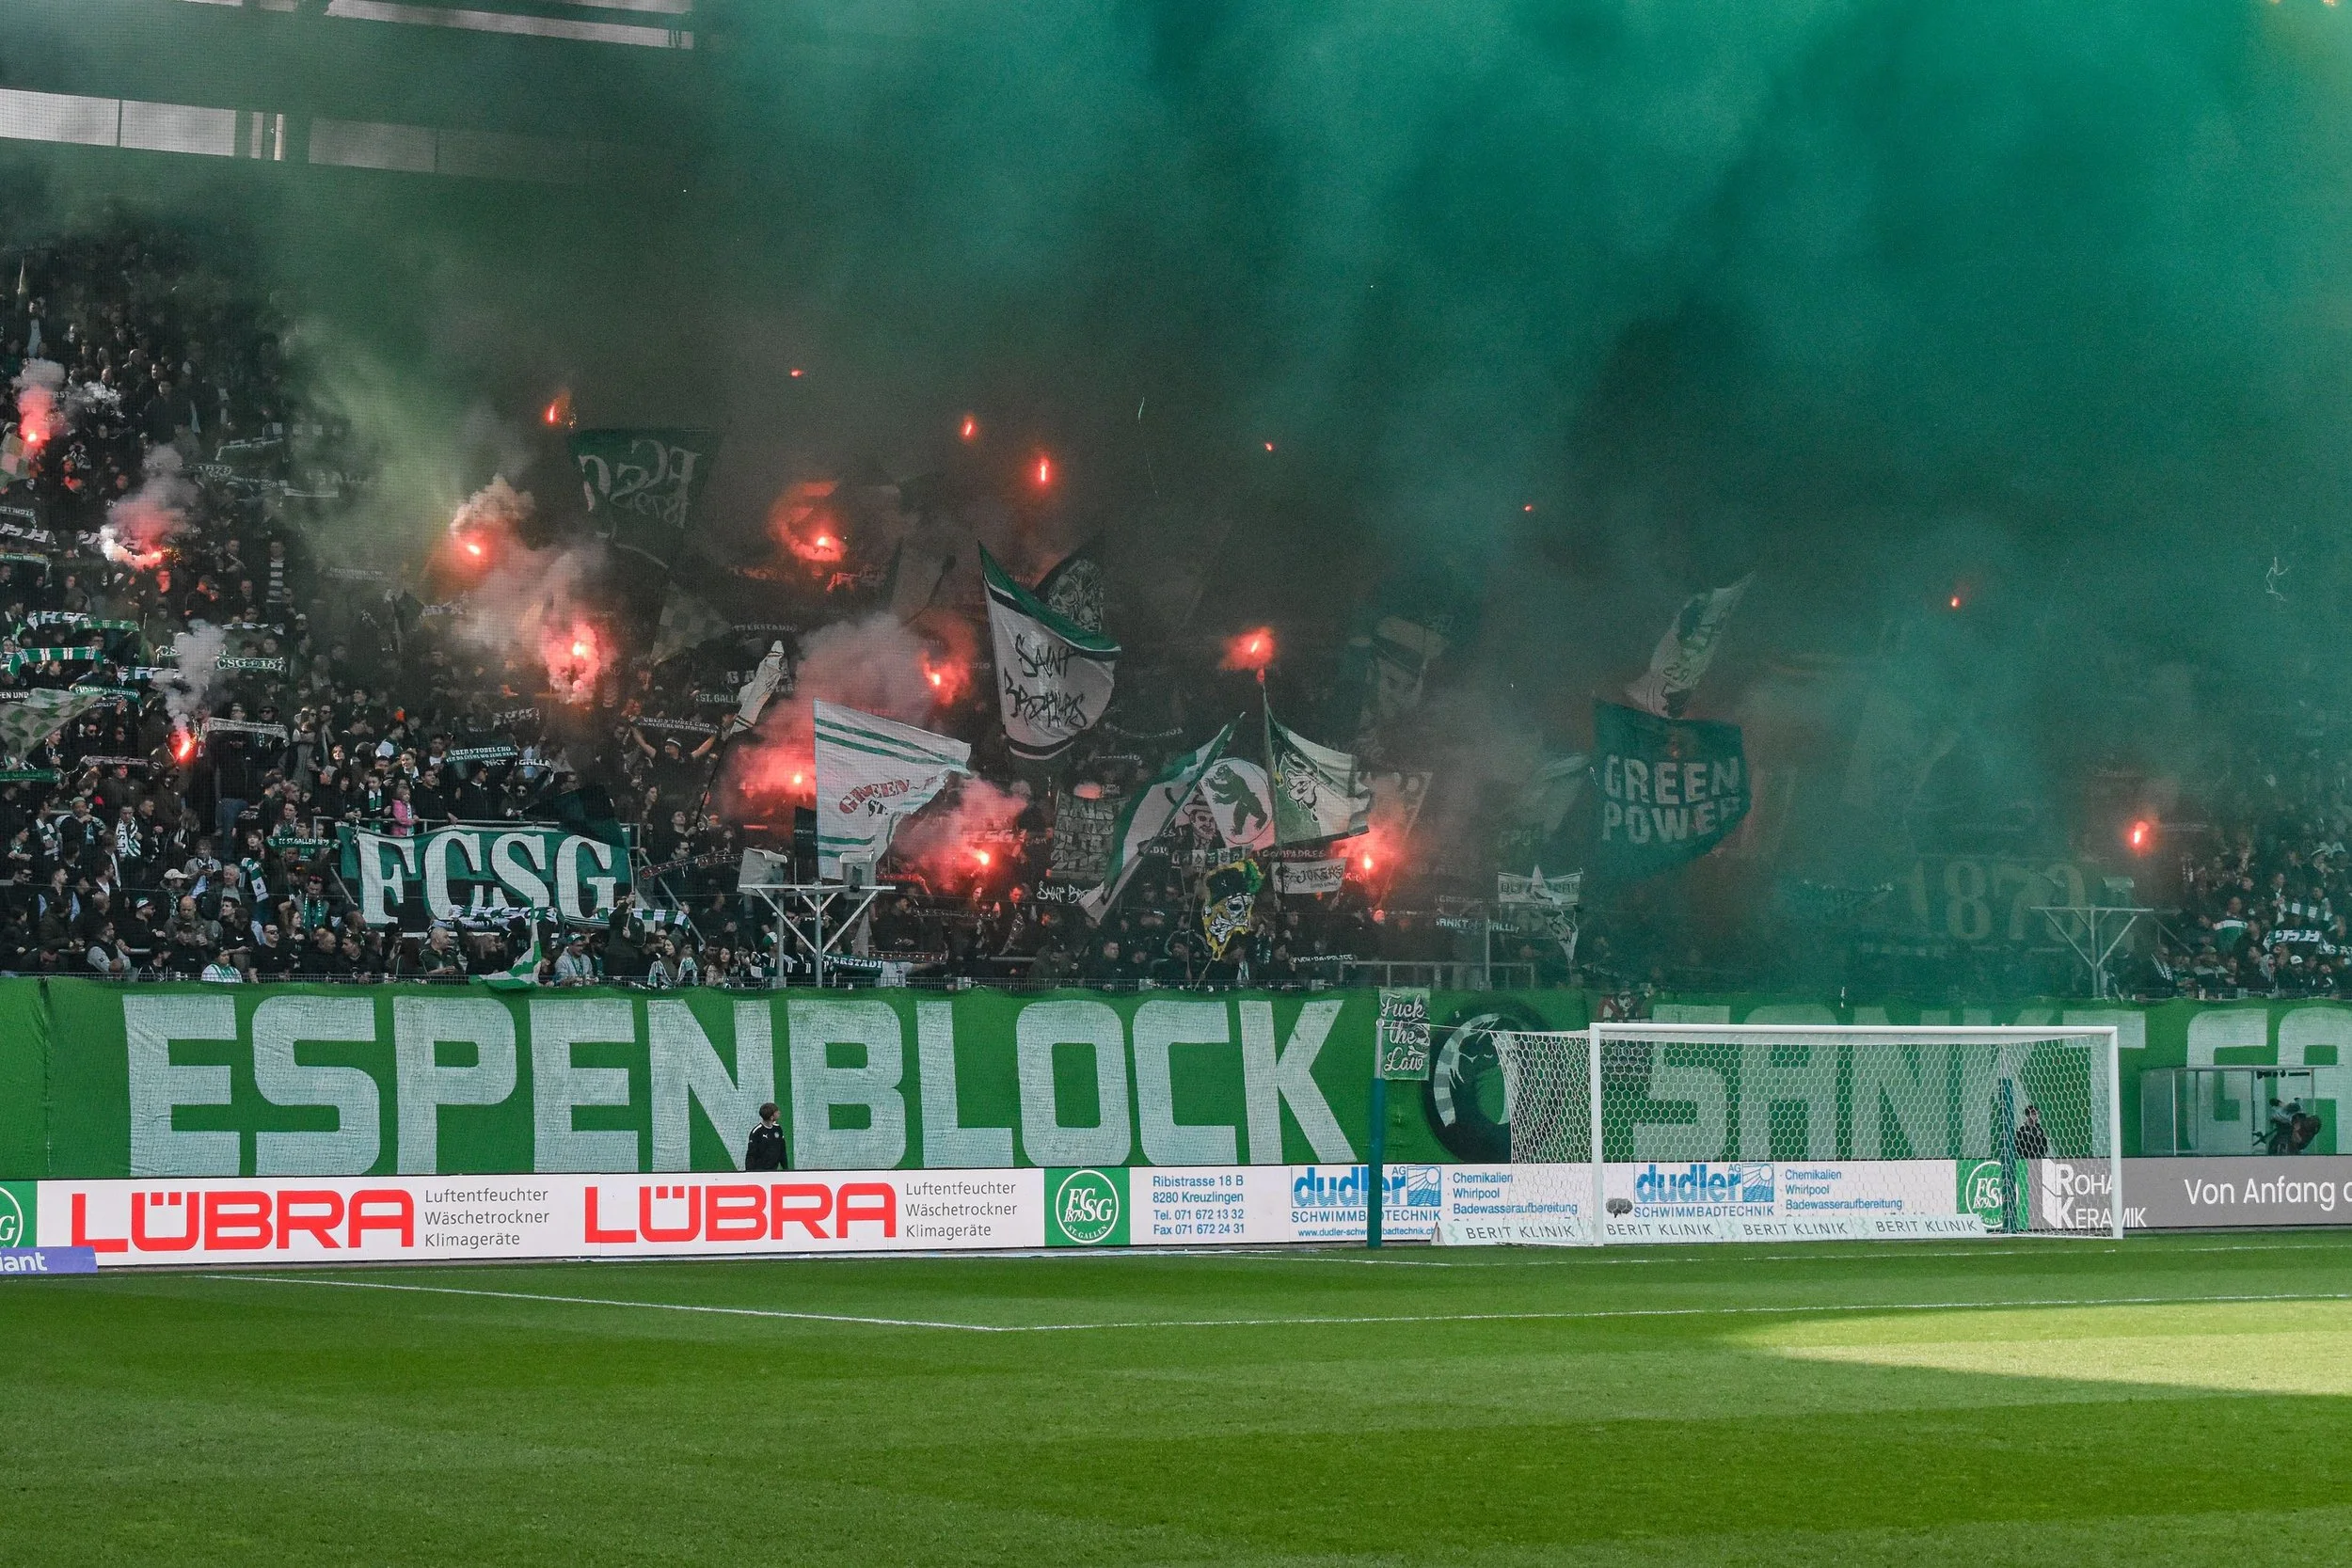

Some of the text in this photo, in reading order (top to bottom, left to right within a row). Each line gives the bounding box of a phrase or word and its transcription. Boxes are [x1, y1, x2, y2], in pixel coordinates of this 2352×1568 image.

[1605, 753, 1739, 806] GREEN
[358, 831, 619, 924] FCSG
[1380, 992, 1425, 1019] Fuck
[1389, 1022, 1418, 1045] the
[1384, 1046, 1424, 1071] Law
[123, 995, 1353, 1178] ESPENBLOCK
[1632, 1003, 2146, 1160] SANKT
[1391, 1166, 1406, 1176] AG
[1728, 1164, 1740, 1173] AG
[1785, 1169, 1841, 1180] Chemikalien
[1152, 1175, 1244, 1187] Ribistrasse 18 B
[1453, 1172, 1513, 1183] Chemikalien
[1636, 1164, 1740, 1203] dudler
[425, 1188, 548, 1203] Luftentfeuchter
[906, 1181, 1016, 1196] Luftentfeuchter
[1453, 1188, 1500, 1200] Whirlpool
[1785, 1184, 1830, 1196] Whirlpool
[2185, 1179, 2233, 1205] Von
[2243, 1175, 2335, 1212] Anfang
[1152, 1191, 1244, 1205] 8280 Kreuzlingen
[1786, 1198, 1902, 1211] Badewasseraufbereitung
[585, 1182, 896, 1243] LÜBRA
[906, 1202, 1018, 1217] Wäschetrockner
[1153, 1209, 1244, 1220] Tel. 071 672 13 32
[1453, 1203, 1578, 1215] Badewasseraufbereitung
[1634, 1205, 1774, 1218] SCHWIMMBADTECHNIK
[72, 1189, 414, 1253] LÜBRA
[425, 1210, 549, 1225] Wäschetrockner
[1292, 1210, 1441, 1223] SCHWIMMBTECHNIK
[906, 1223, 992, 1240] Klimageräte
[1078, 1225, 1108, 1240] GALLEN
[1153, 1224, 1245, 1235] Fax 071 672 24 31
[1466, 1226, 1575, 1240] BERIT KLINIK
[1607, 1224, 1714, 1236] BERIT KLINIK
[1744, 1223, 1848, 1236] BERIT KLINIK
[1876, 1220, 1978, 1233] BERIT KLINIK
[425, 1231, 520, 1249] Klimageräte
